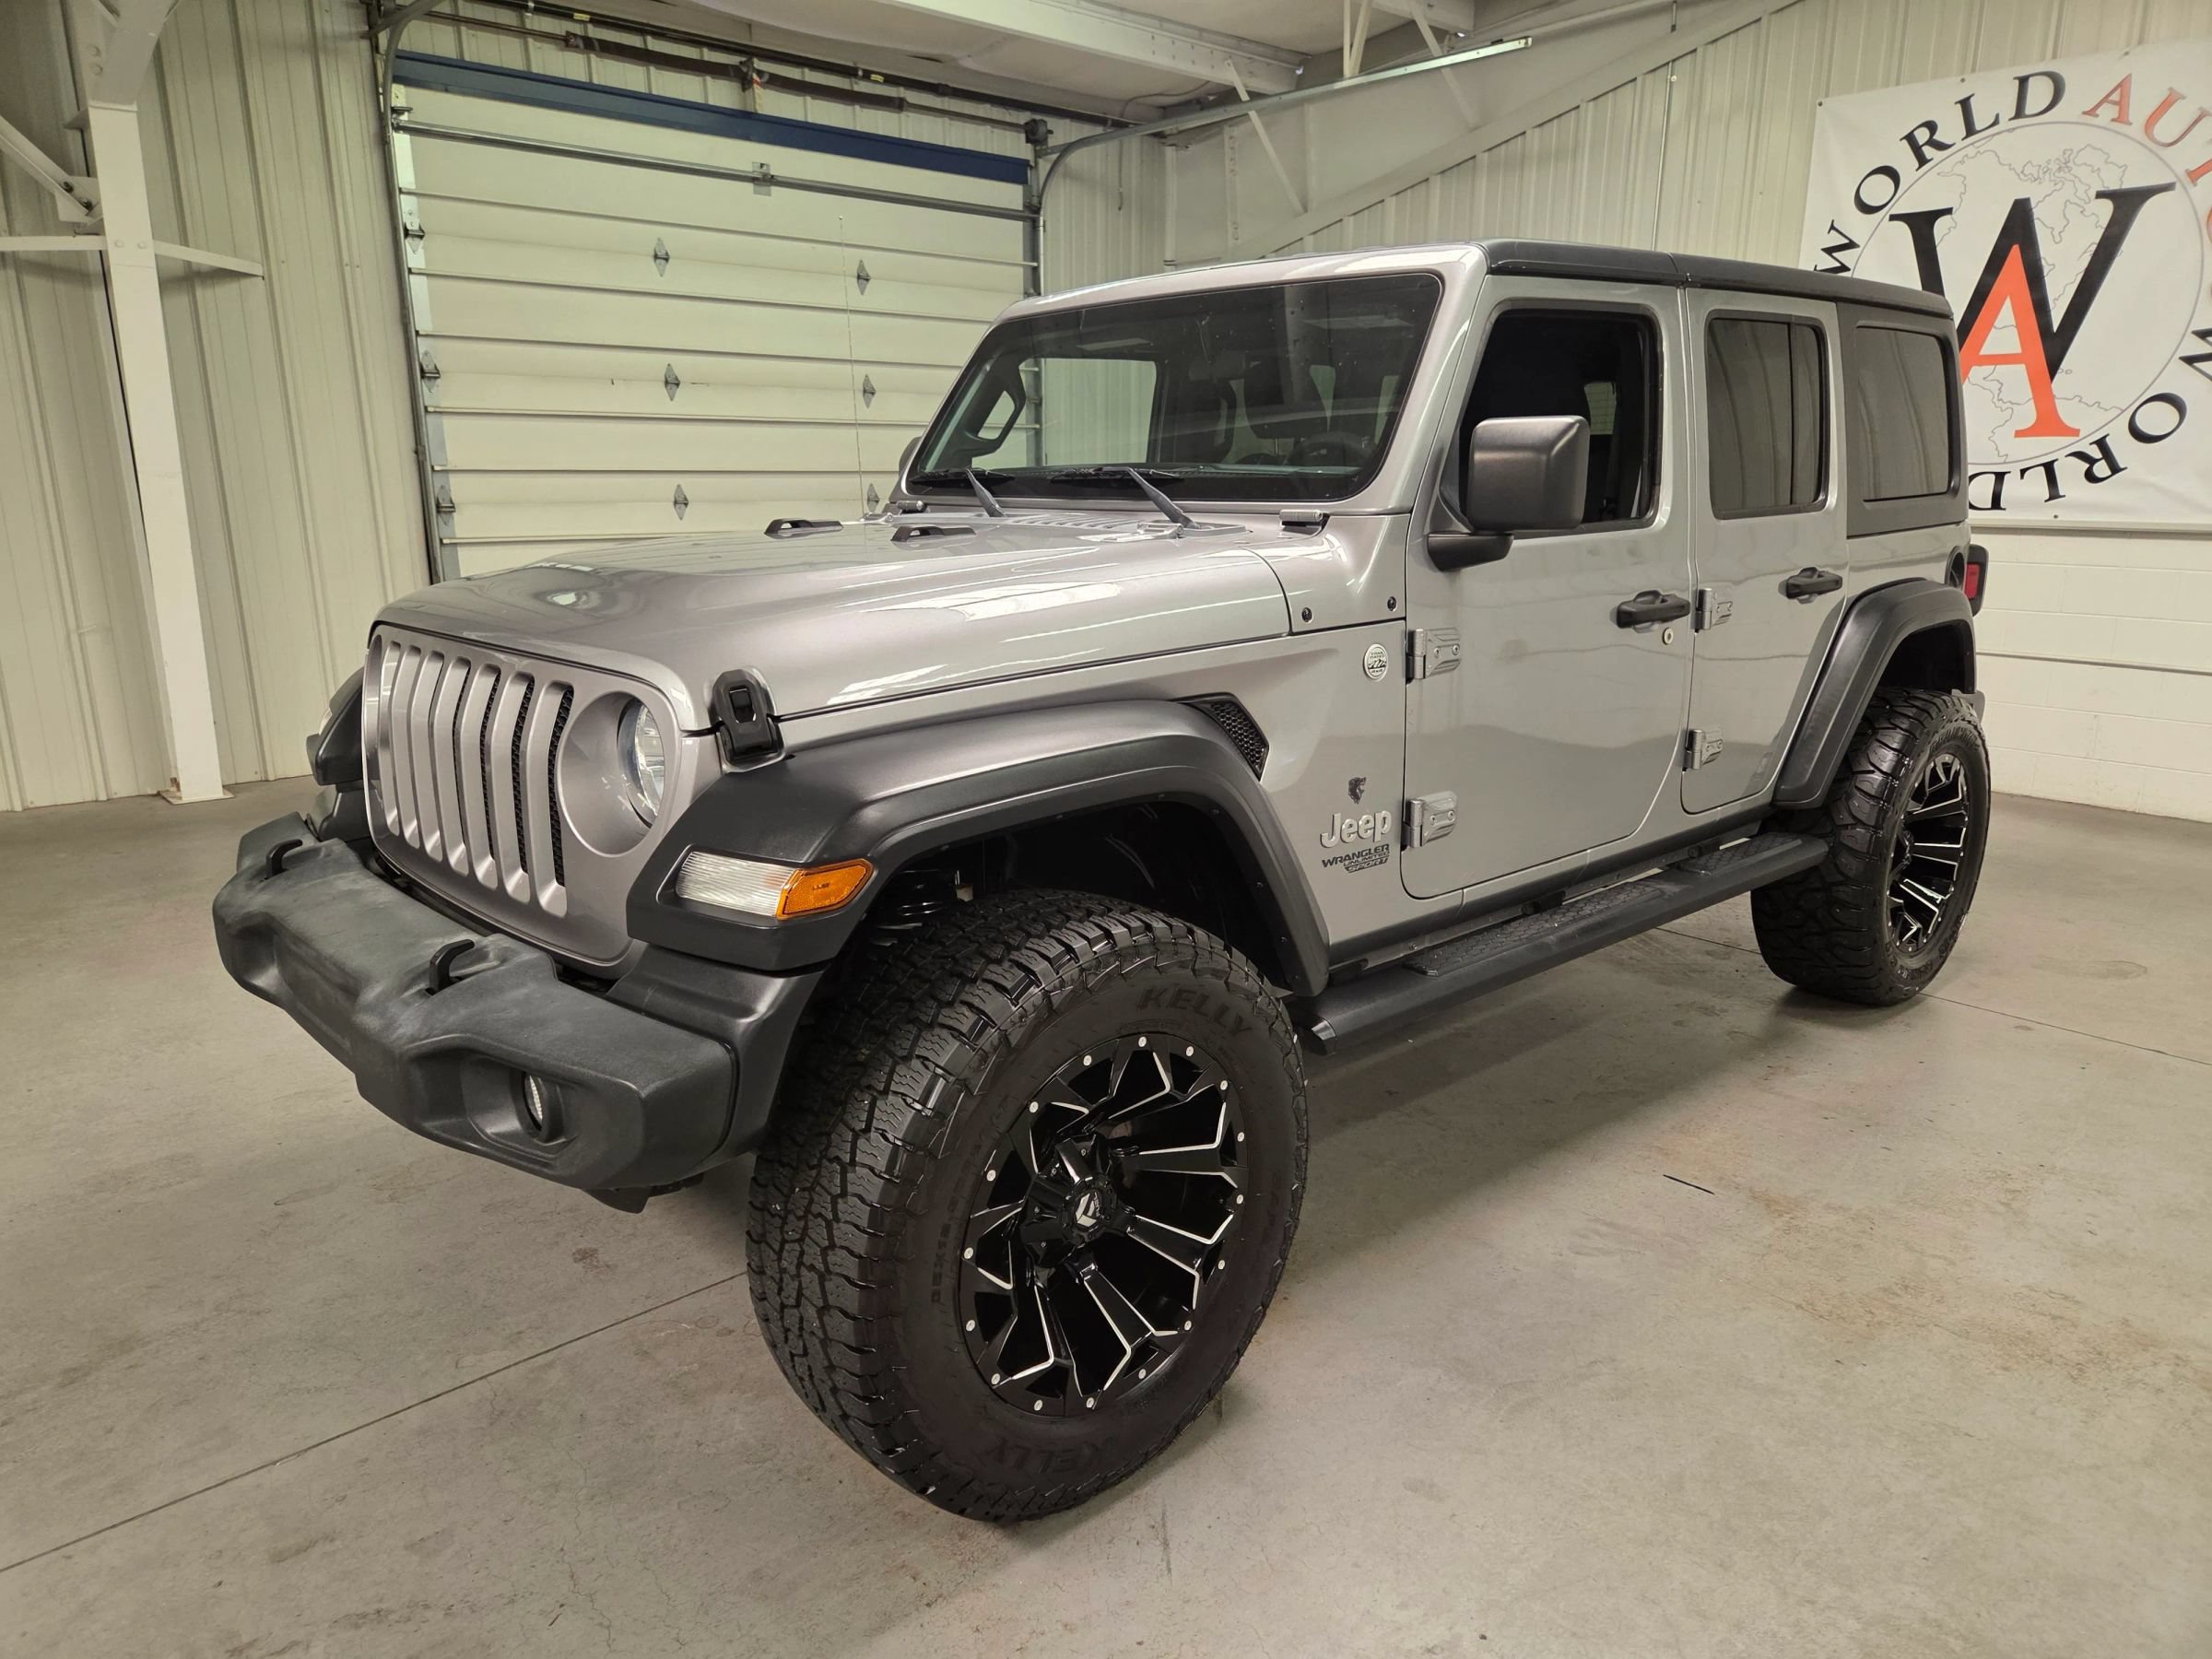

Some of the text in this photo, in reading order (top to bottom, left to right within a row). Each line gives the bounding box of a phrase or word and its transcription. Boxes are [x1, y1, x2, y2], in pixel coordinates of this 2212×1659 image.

[1320, 810, 1392, 848] Jeep
[1322, 843, 1390, 868] WRANGLER
[1343, 851, 1391, 867] UNLIMITED
[1135, 986, 1253, 1037] KELLY
